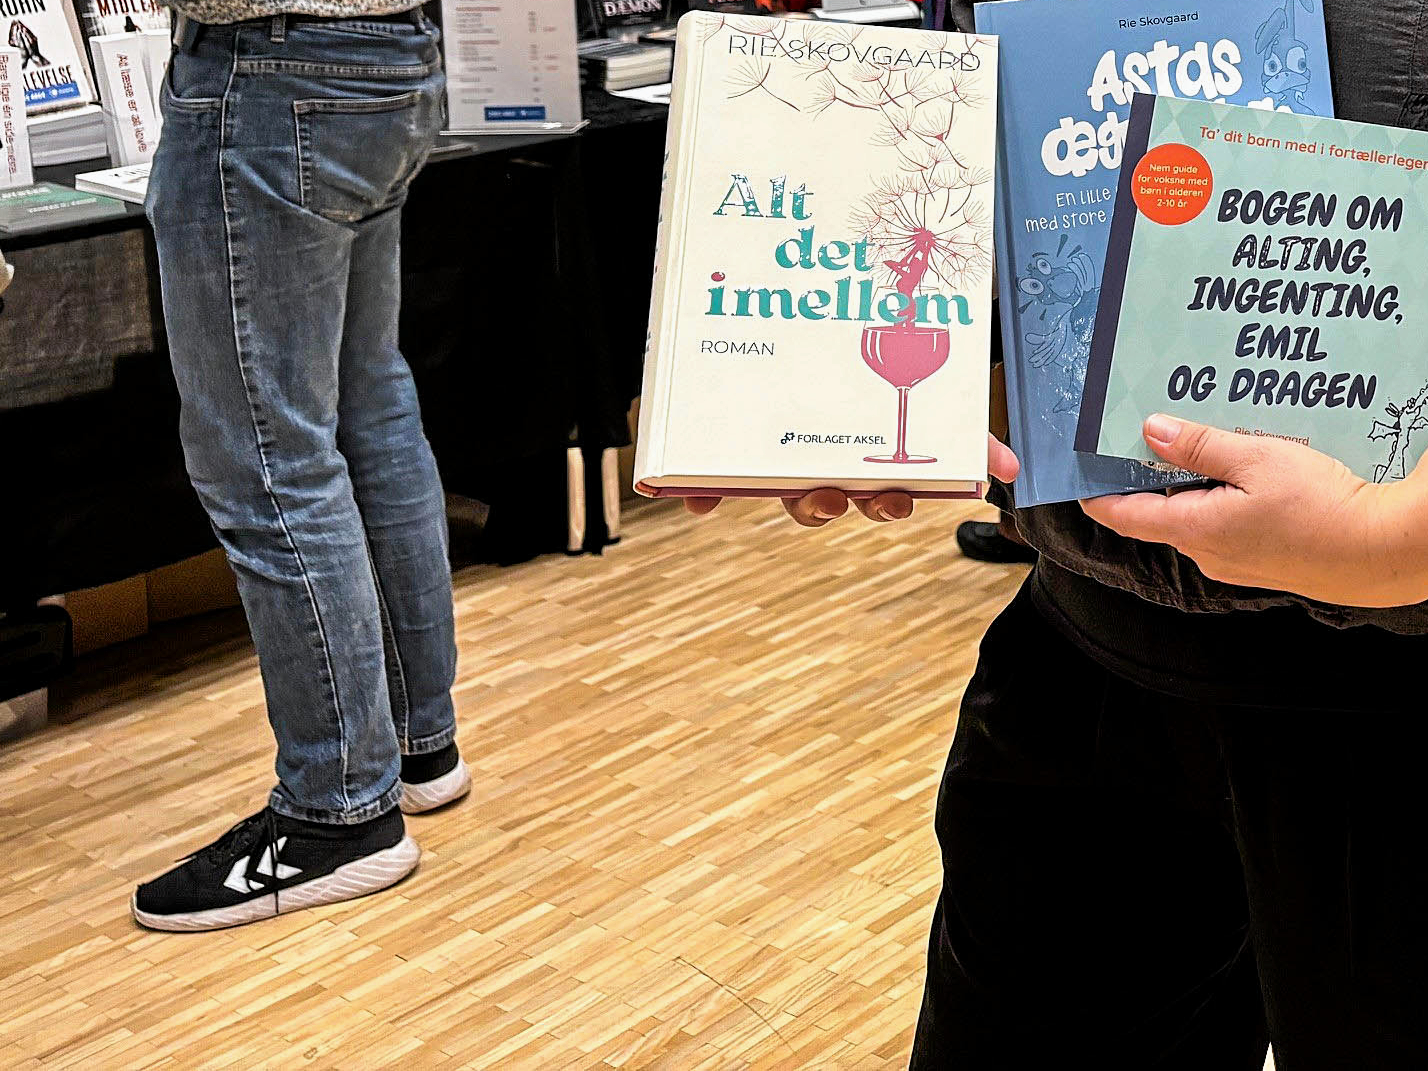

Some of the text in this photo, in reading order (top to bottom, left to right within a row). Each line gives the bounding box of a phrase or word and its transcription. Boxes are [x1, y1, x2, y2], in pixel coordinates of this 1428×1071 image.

[1118, 11, 1199, 29] Rie Skovgaard
[728, 34, 981, 72] RIE SKOVGAARD
[23, 64, 74, 91] LEVELSE
[1087, 38, 1243, 112] Astas
[1224, 130, 1243, 144] dit
[1247, 132, 1280, 149] barn
[1285, 139, 1317, 154] med
[1320, 143, 1325, 155] i
[1137, 174, 1208, 186] for voksne med
[1149, 164, 1198, 175] Nem guide
[712, 174, 814, 221] Alt
[1056, 192, 1077, 208] En
[1140, 185, 1162, 195] børn
[1169, 186, 1204, 197] alderen
[1157, 198, 1188, 208] 2-10 år
[1025, 208, 1107, 233] med store
[1217, 188, 1403, 232] BOGEN OM
[774, 225, 876, 272] det
[1232, 233, 1371, 278] ALTING,
[704, 271, 974, 326] imellem
[1187, 276, 1403, 325] INGENTING,
[700, 340, 775, 357] ROMAN
[1235, 322, 1328, 362] EMIL
[1167, 364, 1377, 410] OG DRAGEN
[797, 433, 886, 446] FORLAGET AKSEL
